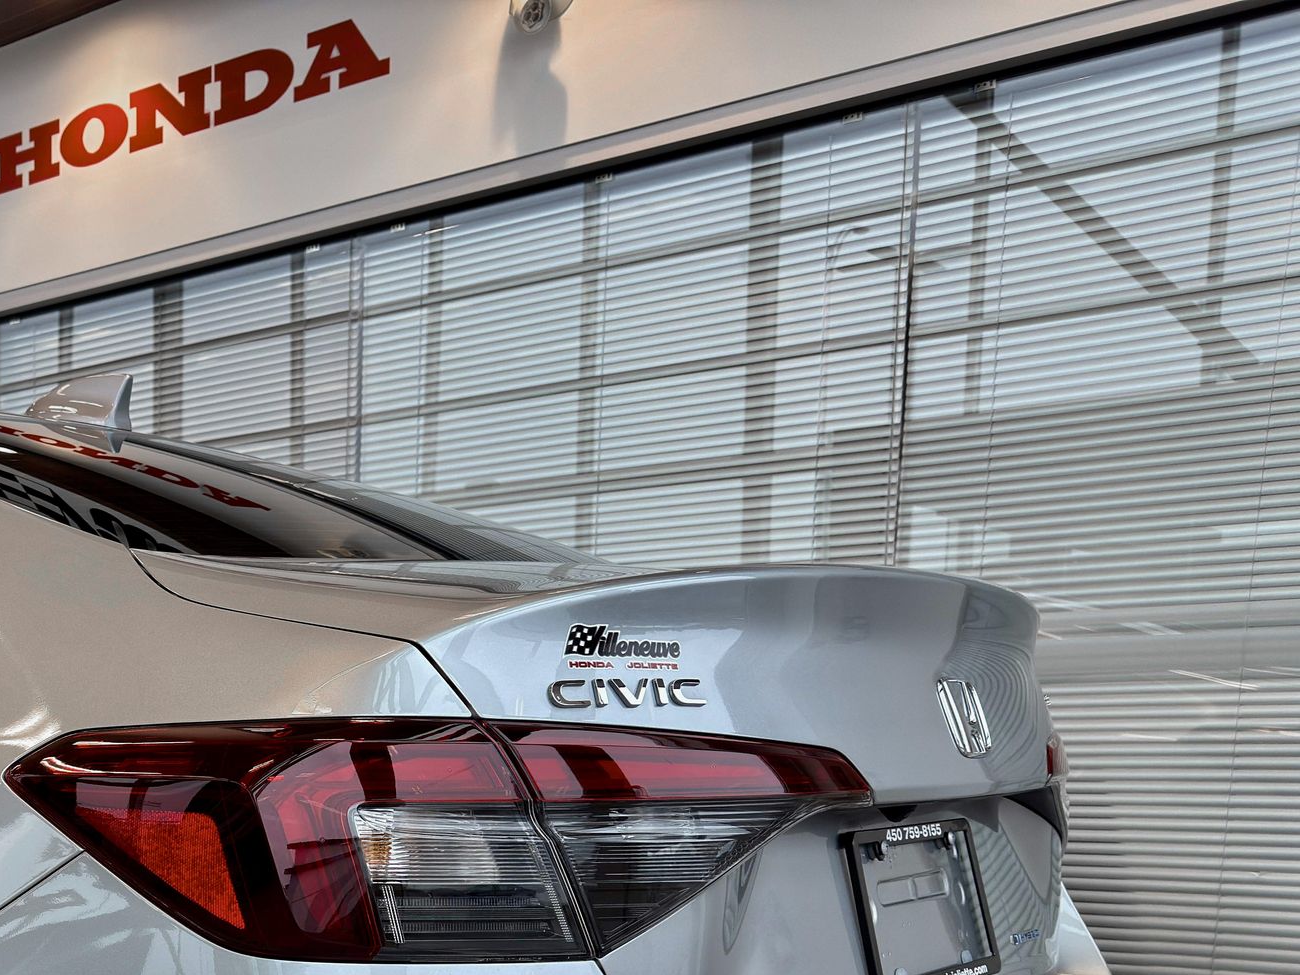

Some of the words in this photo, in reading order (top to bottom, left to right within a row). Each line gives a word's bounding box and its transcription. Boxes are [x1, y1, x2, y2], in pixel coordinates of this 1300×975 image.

[565, 624, 681, 659] Villeneuve
[569, 660, 614, 669] HONDA
[626, 662, 679, 670] JOLIETTE
[547, 678, 708, 709] CIVIC
[886, 827, 903, 842] 450
[903, 823, 942, 840] 759-8155
